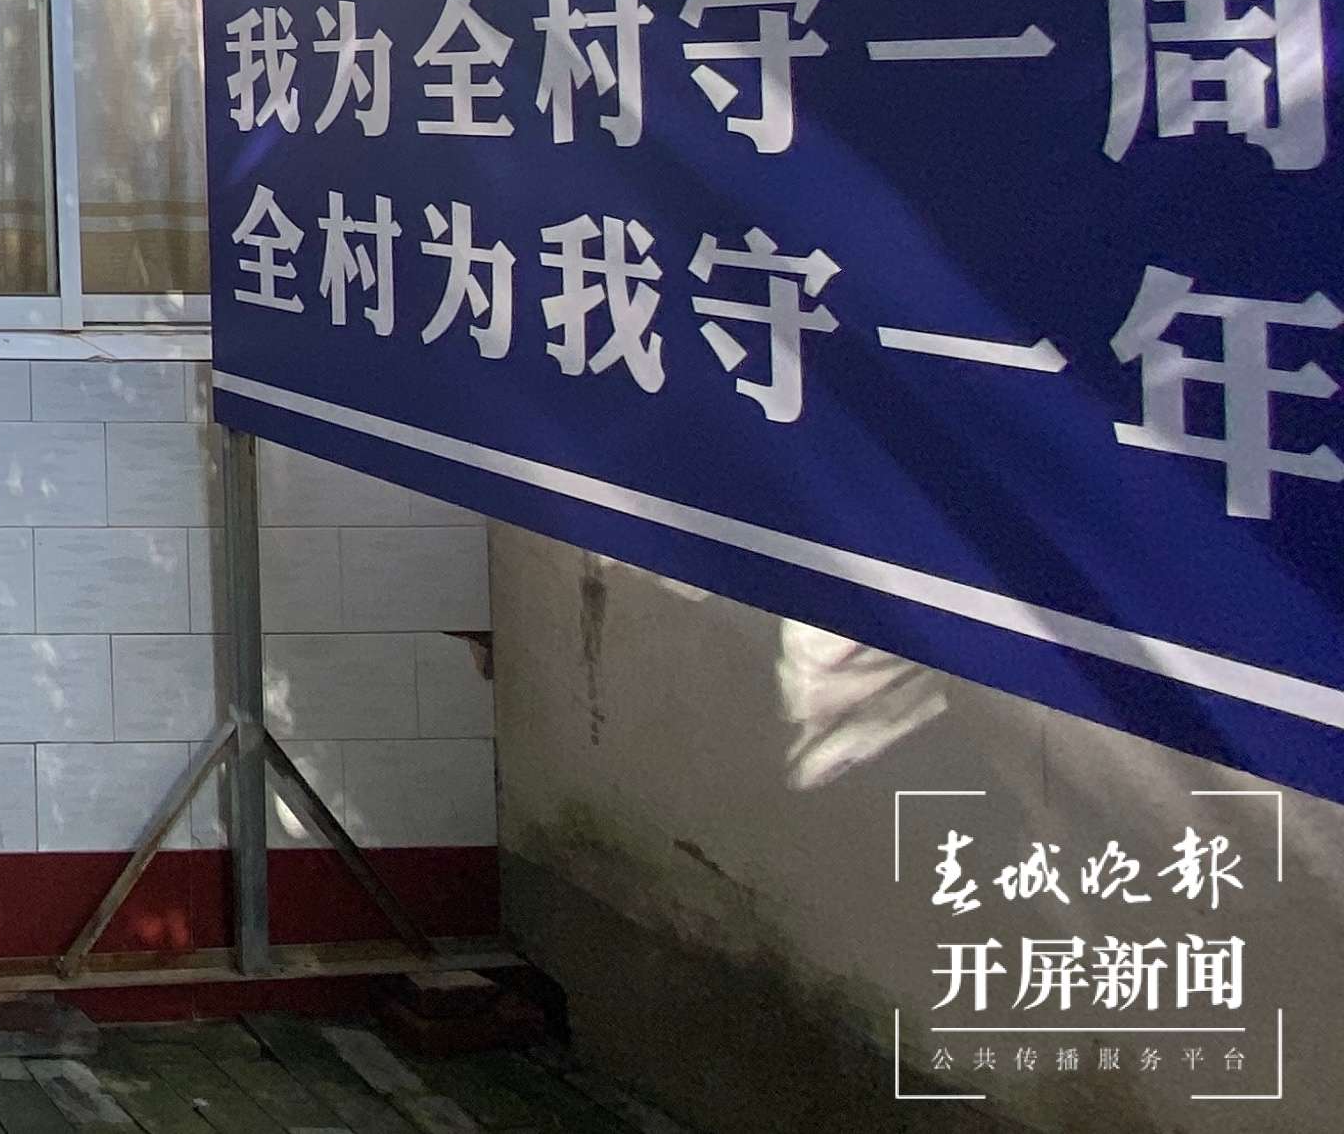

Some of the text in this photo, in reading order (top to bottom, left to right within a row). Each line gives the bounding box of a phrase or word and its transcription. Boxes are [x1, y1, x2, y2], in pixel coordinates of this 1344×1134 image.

[231, 184, 1344, 519] 全村为我守一年
